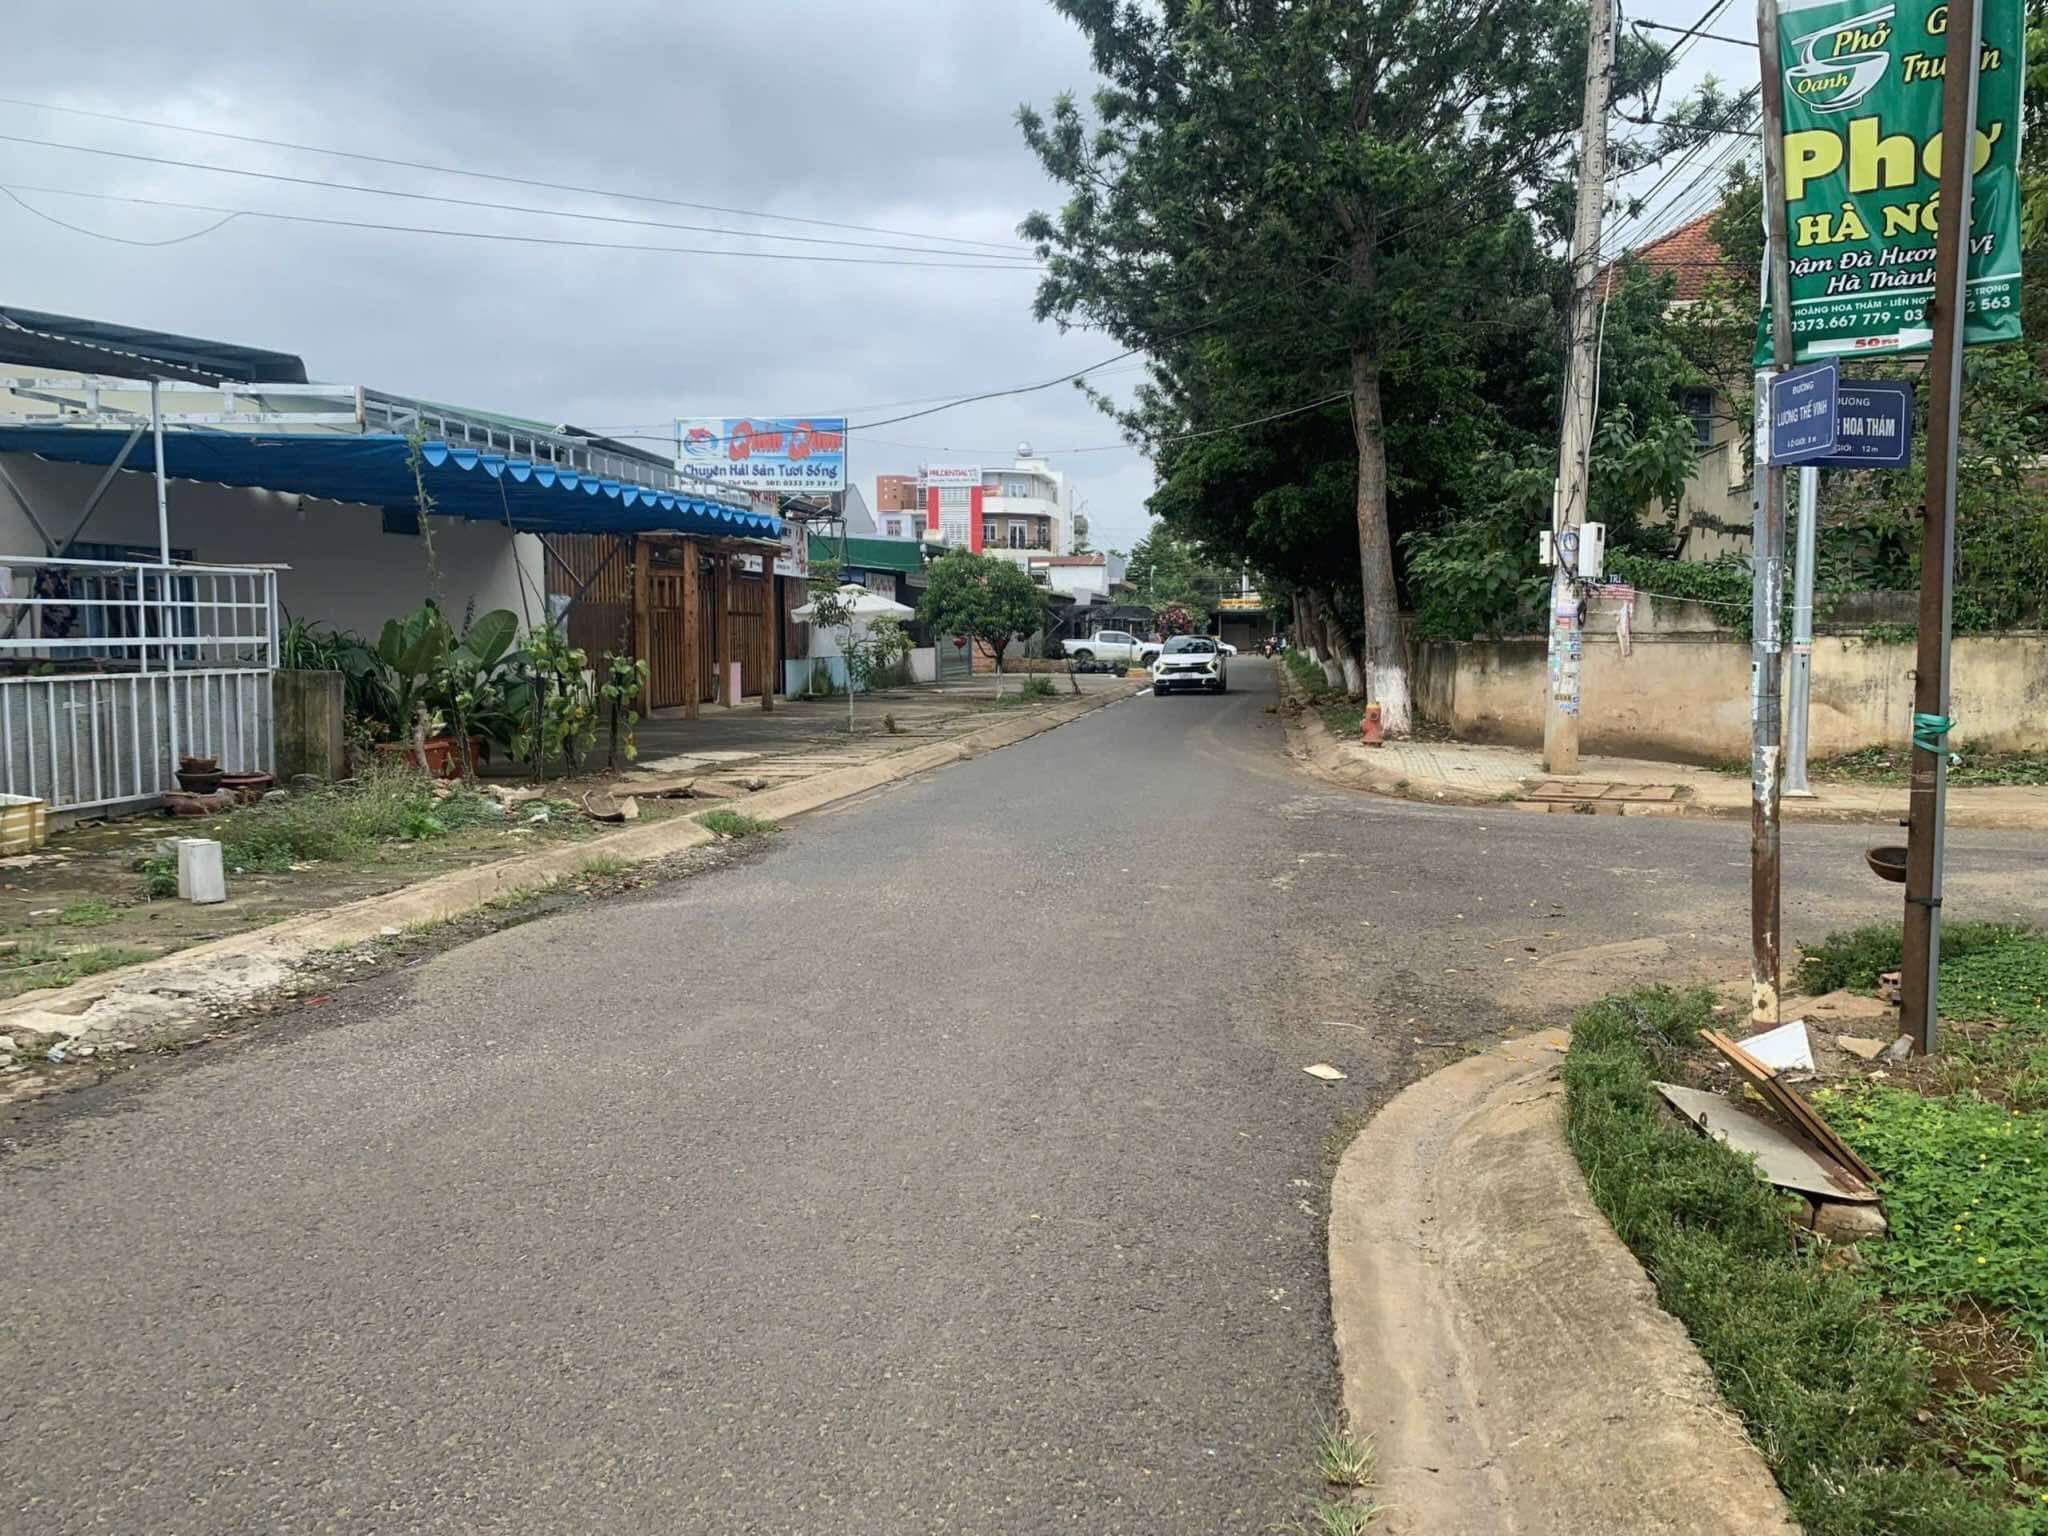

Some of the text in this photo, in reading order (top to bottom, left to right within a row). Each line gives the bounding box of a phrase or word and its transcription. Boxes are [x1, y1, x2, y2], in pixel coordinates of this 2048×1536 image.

[1832, 21, 1892, 57] Phở
[1797, 73, 1849, 95] Oanh
[1796, 202, 1870, 247] HÀ
[1839, 250, 1873, 270] Đà
[1878, 245, 1938, 268] Hươn
[1970, 234, 1995, 255] Vị
[1827, 267, 1937, 295] Hà Thành
[1831, 303, 1853, 313] HOA
[1980, 295, 2011, 311] 563
[1842, 416, 1864, 436] HOA
[1866, 413, 1895, 437] THÁM
